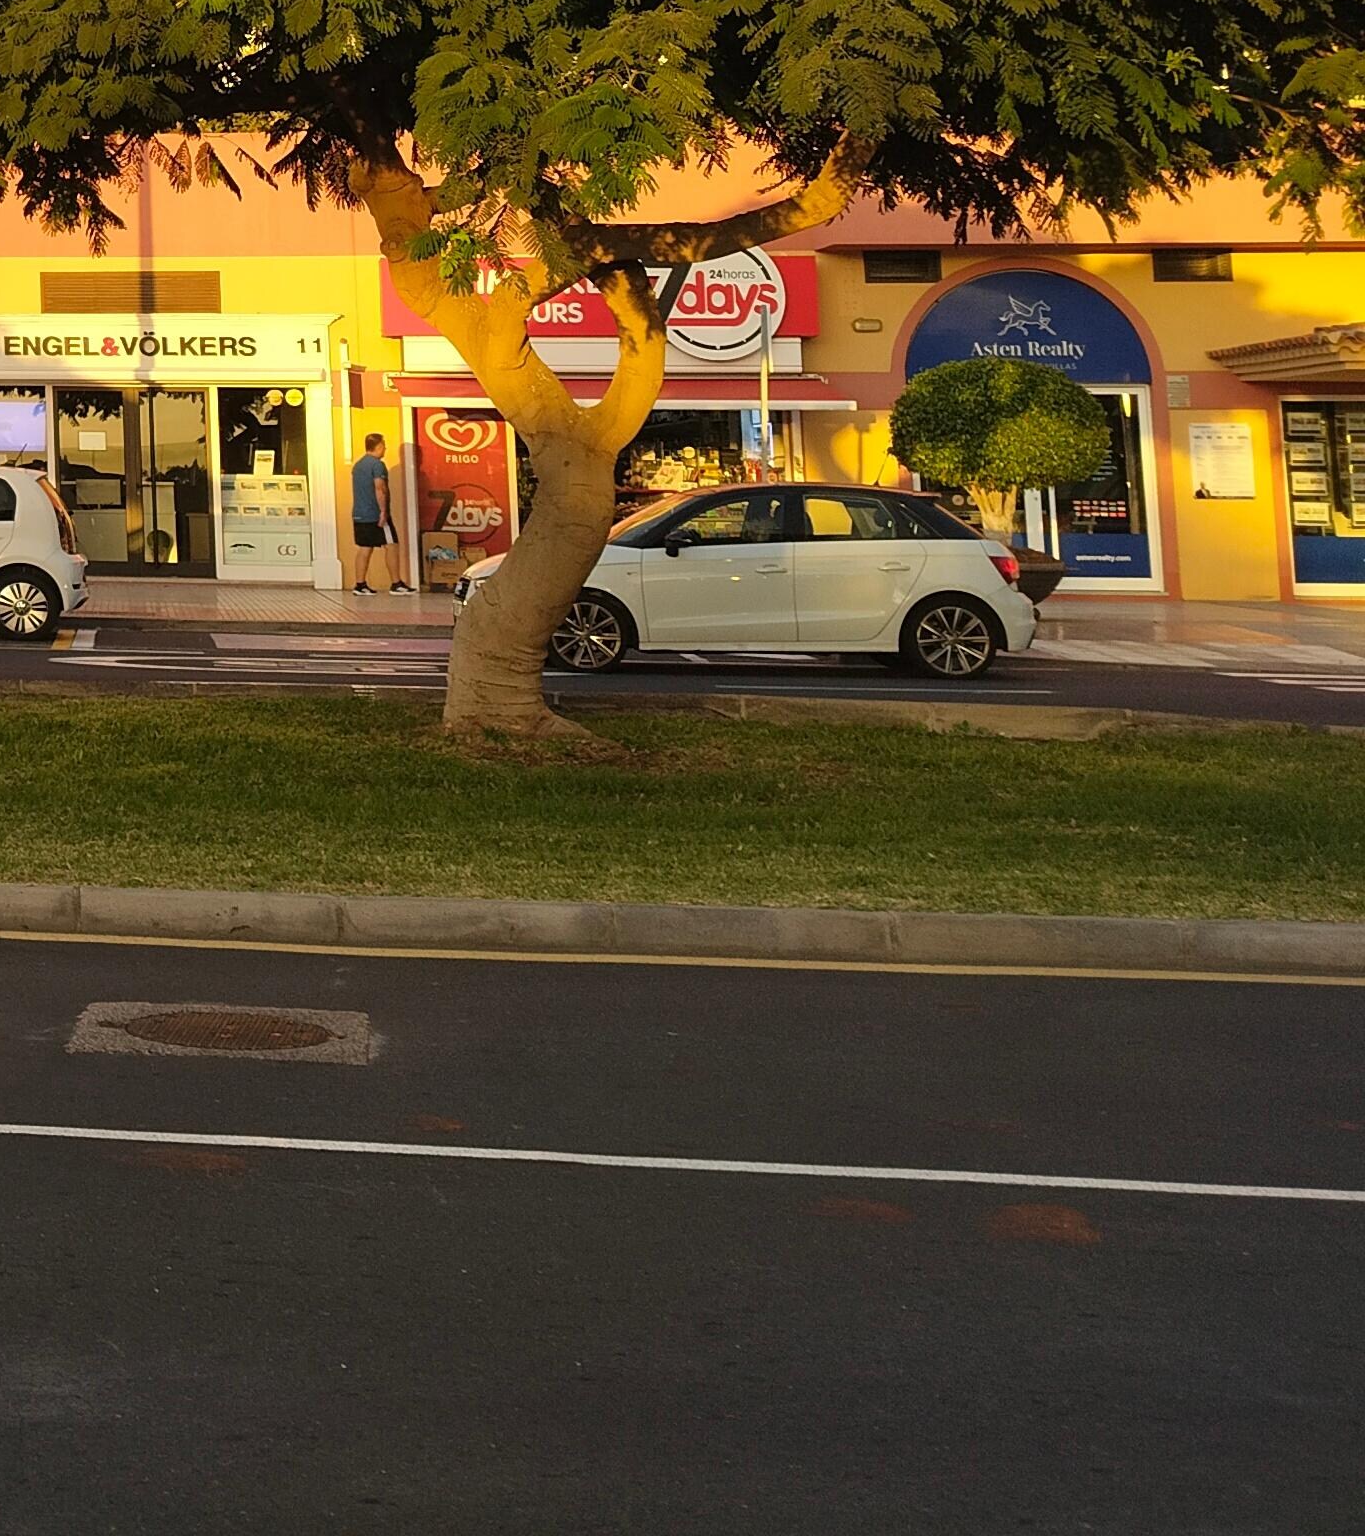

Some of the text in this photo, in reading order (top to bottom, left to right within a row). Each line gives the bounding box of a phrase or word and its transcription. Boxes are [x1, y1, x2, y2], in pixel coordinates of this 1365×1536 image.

[708, 268, 756, 280] 24horas
[3, 331, 257, 357] ENGEL&VÖLKERS
[296, 338, 323, 354] 11
[971, 340, 1086, 359] Asten Realty
[445, 454, 479, 463] FRIGO
